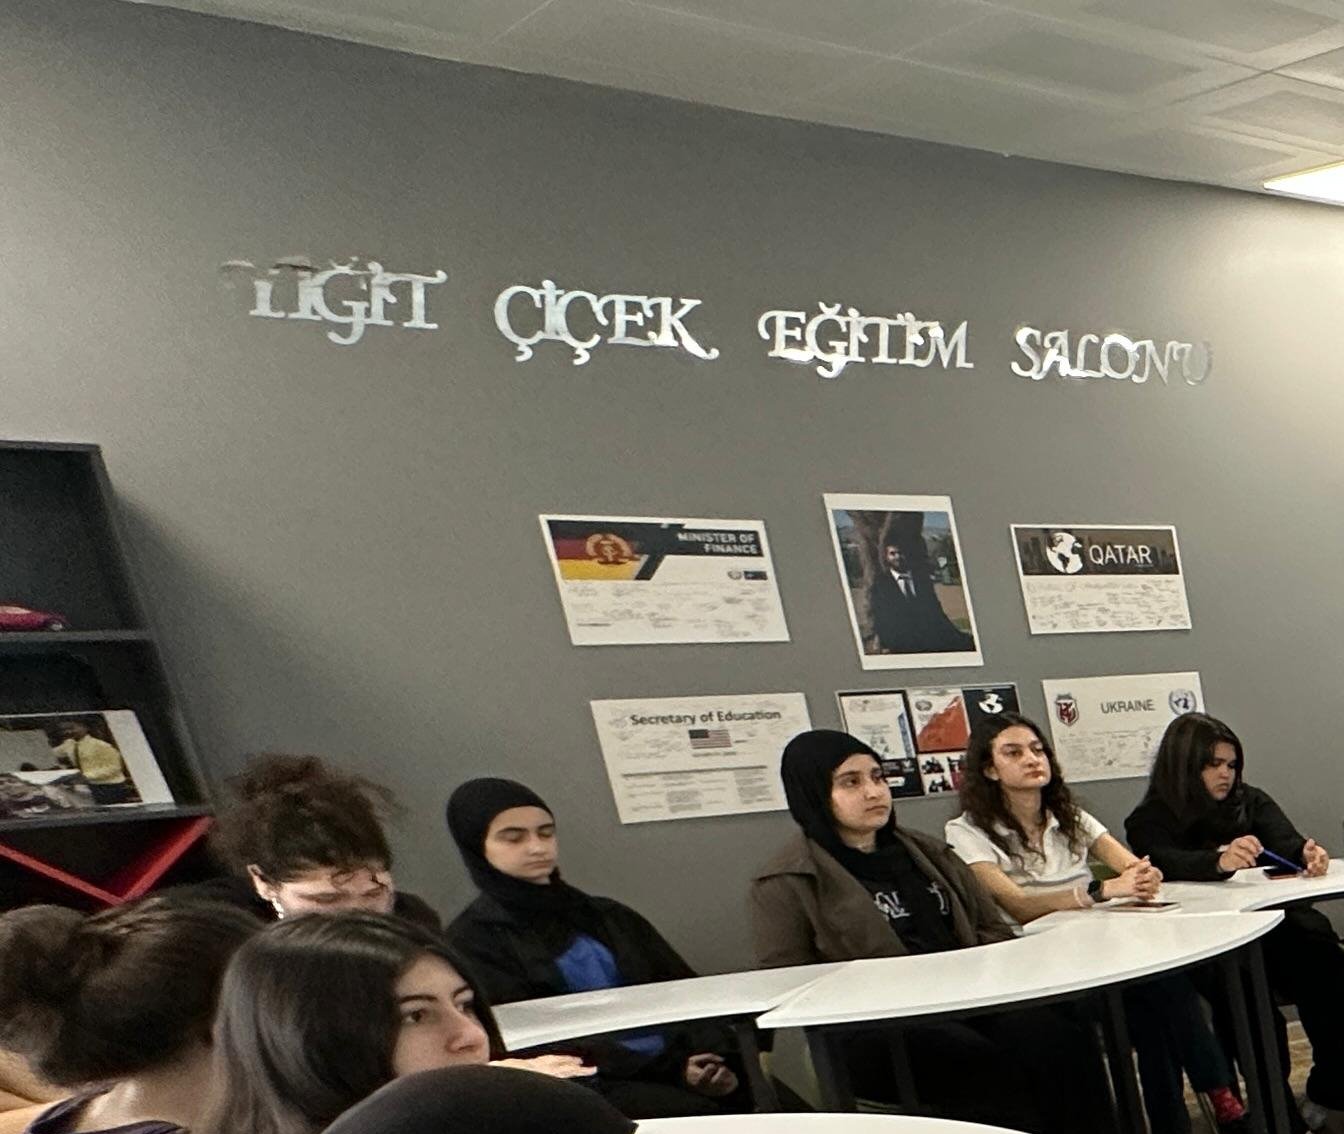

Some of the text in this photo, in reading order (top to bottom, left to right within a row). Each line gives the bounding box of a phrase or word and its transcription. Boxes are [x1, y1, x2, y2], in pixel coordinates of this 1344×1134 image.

[494, 280, 720, 366] ÇİÇEK
[757, 301, 975, 378] EĞİTİM
[1011, 326, 1213, 386] SALONU
[677, 532, 755, 544] MINISTER OF
[704, 543, 758, 554] FINANCE
[1089, 544, 1152, 566] QATAR
[1100, 699, 1156, 714] UKRAINE
[630, 710, 781, 726] Secretary of Education
